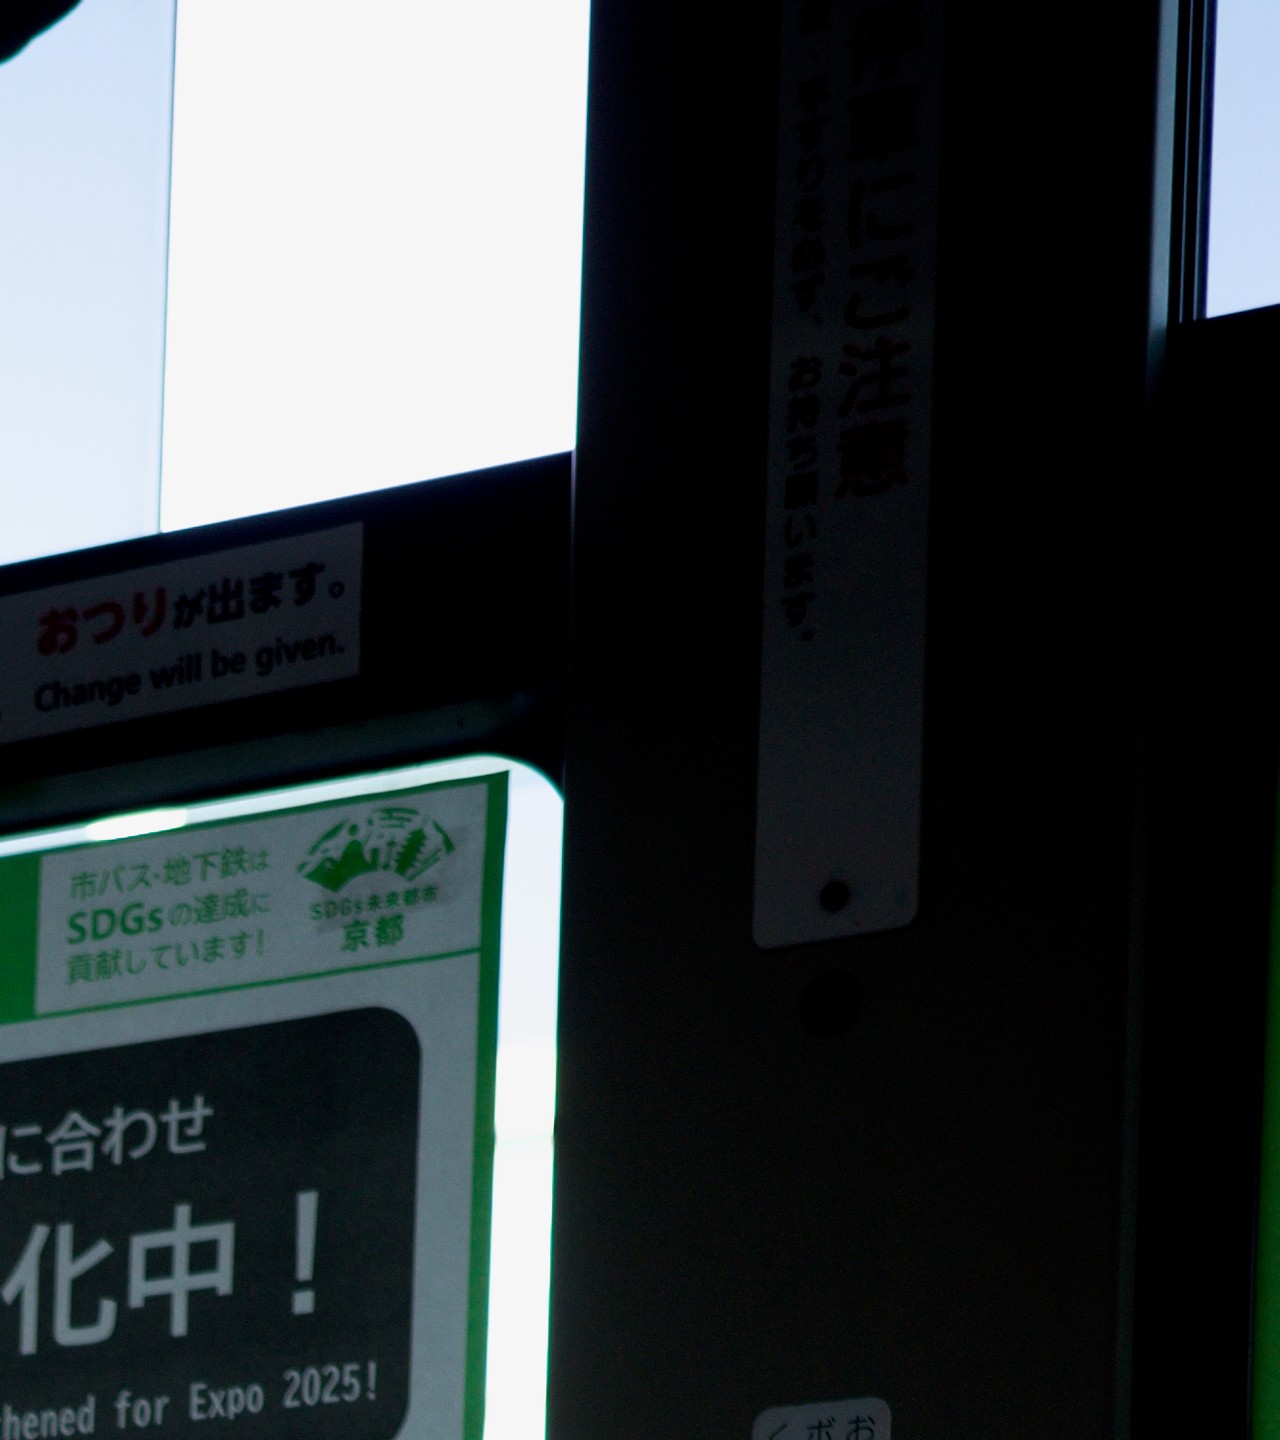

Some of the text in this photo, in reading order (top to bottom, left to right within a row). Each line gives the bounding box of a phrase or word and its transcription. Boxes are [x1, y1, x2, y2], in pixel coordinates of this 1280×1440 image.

[36, 562, 346, 656] おつりが出ます。
[35, 629, 346, 714] Change will be given.
[70, 845, 270, 901] 市バス・地下鉄は
[340, 914, 405, 953] 京都
[114, 1390, 169, 1431] for
[188, 1377, 264, 1426] Expo
[283, 1362, 380, 1410] 2025!
